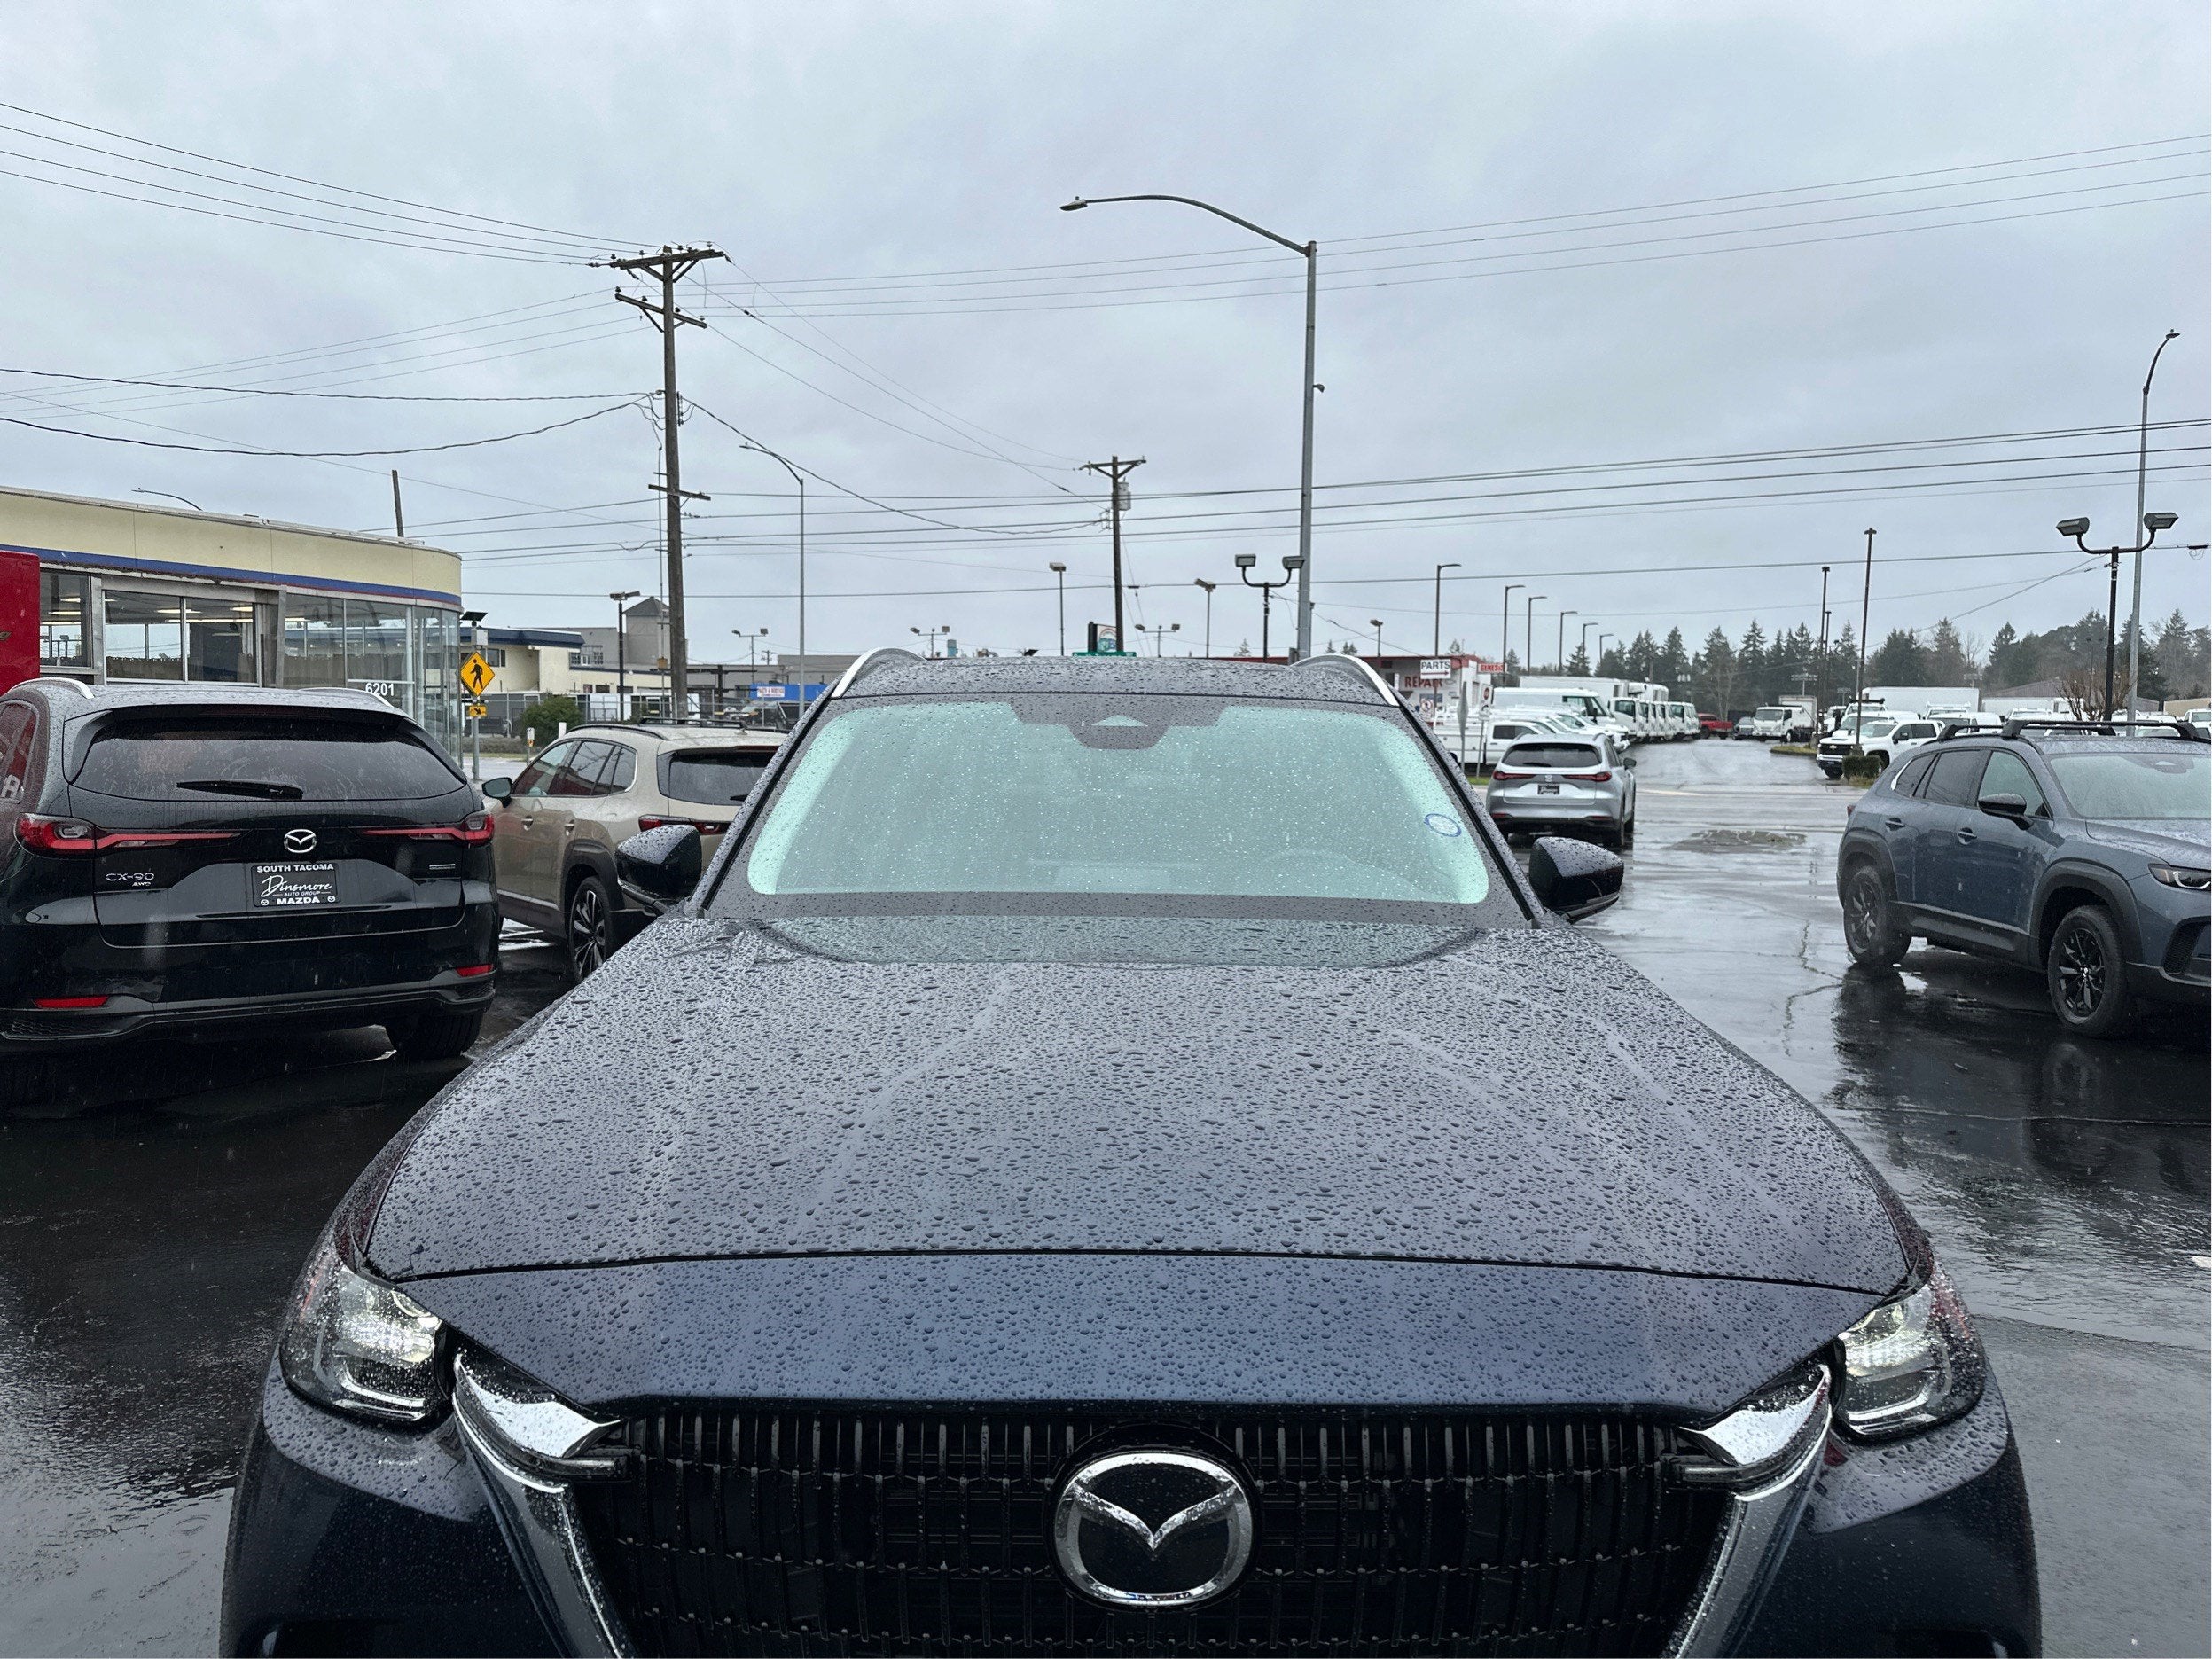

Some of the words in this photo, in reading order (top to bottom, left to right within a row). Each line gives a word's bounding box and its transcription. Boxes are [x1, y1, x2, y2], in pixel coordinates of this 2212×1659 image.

[1421, 661, 1450, 669] PARTS
[365, 682, 395, 696] 6201
[256, 865, 291, 873] SOUTH
[293, 863, 334, 872] TACOMA
[106, 873, 154, 881] CX-90
[260, 874, 332, 897] Dinsmore
[276, 896, 320, 905] MAZDA
